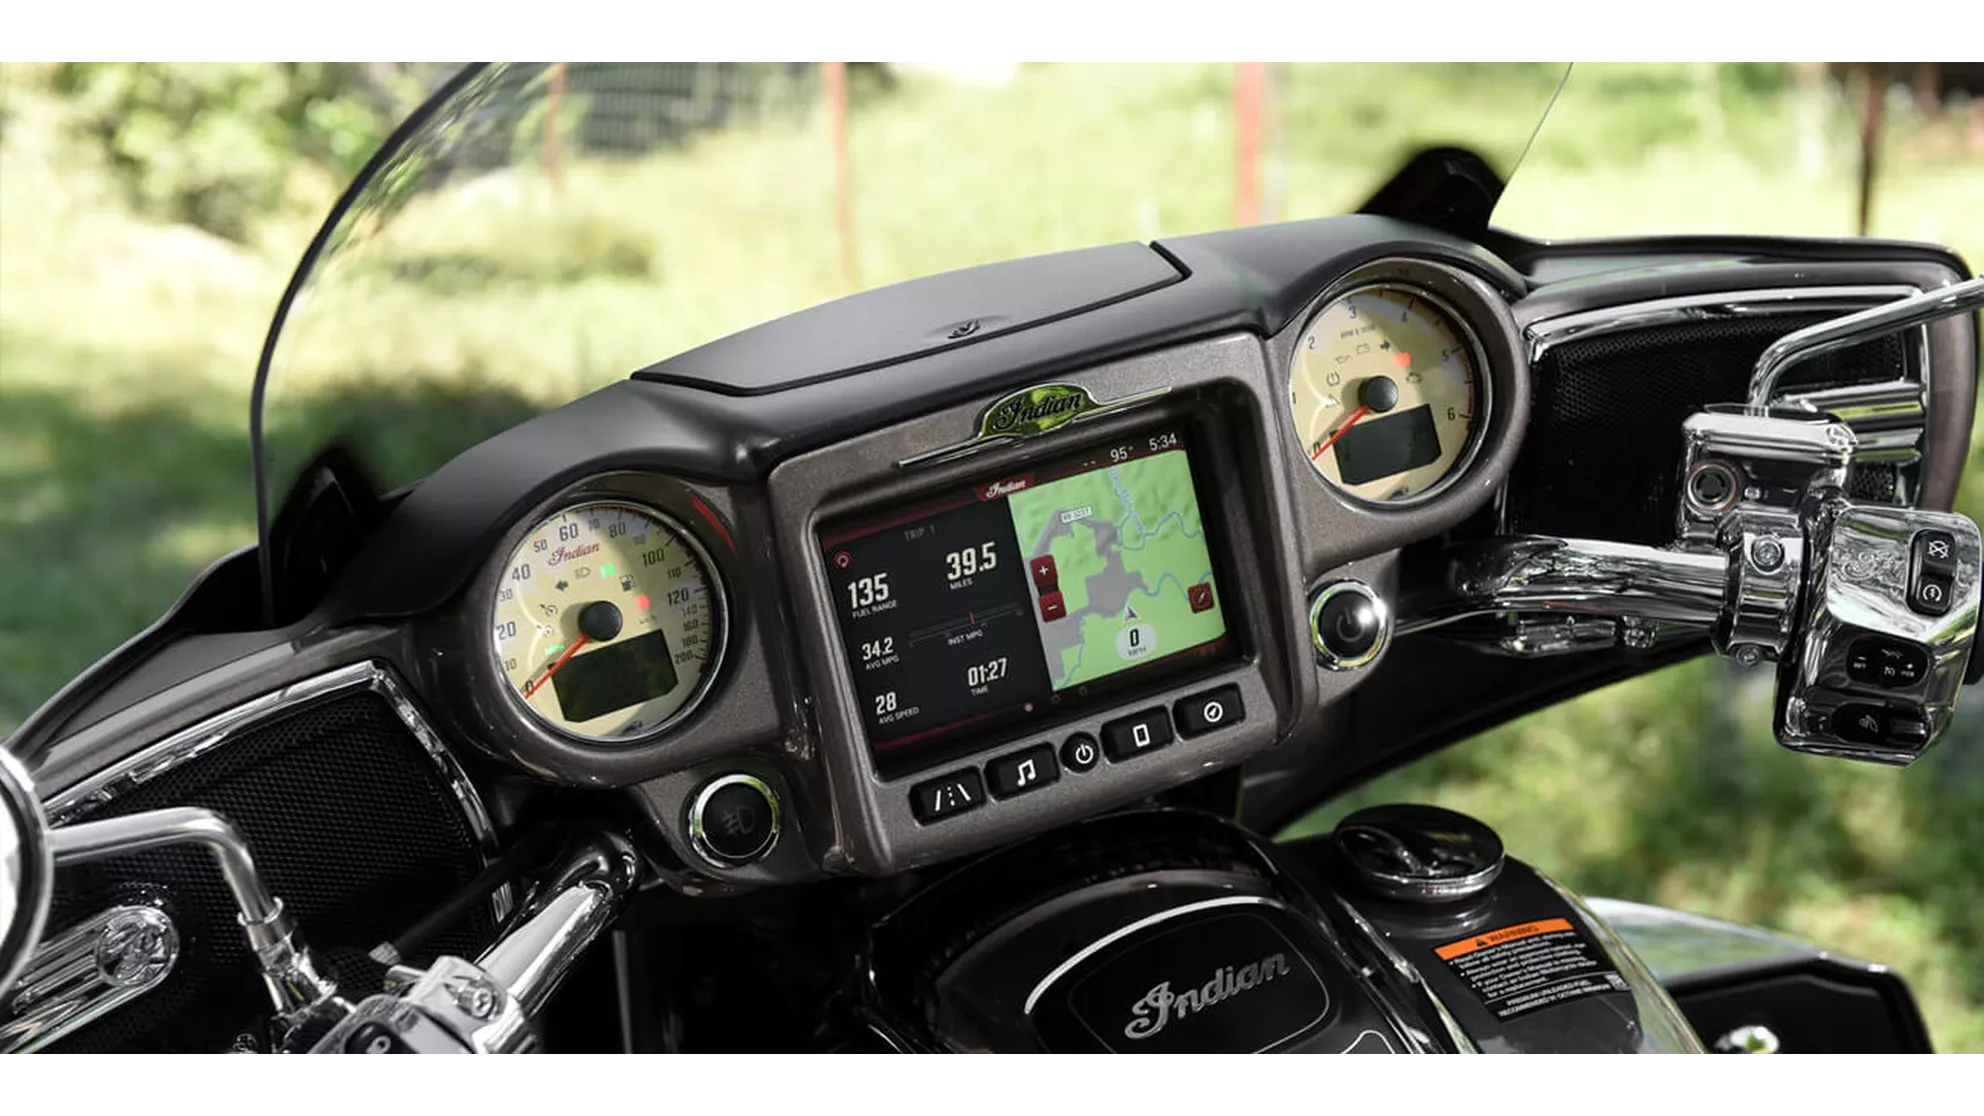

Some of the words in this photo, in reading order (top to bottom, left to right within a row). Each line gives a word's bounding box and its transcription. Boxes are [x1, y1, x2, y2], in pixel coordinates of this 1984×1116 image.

[1349, 305, 1357, 319] 3
[1308, 336, 1316, 349] 2
[994, 392, 1082, 430] Indian
[1447, 408, 1456, 422] 6
[1149, 433, 1177, 451] 5:34
[986, 479, 1026, 498] Indian
[560, 523, 579, 541] 60
[609, 522, 627, 539] 80
[904, 527, 926, 541] TRIP
[533, 539, 548, 553] 50
[547, 543, 601, 567] Indian
[642, 549, 665, 567] 100
[946, 542, 997, 580] 39.5
[512, 564, 531, 581] 40
[848, 572, 889, 610] 135
[950, 578, 973, 590] MILES
[500, 588, 513, 602] 30
[667, 587, 690, 607] 120
[852, 605, 872, 619] FUEL
[872, 600, 897, 613] RANGE
[496, 621, 516, 641] 20
[948, 634, 965, 646] INST
[966, 629, 984, 641] MPG
[1130, 628, 1139, 647] 0
[861, 637, 893, 660] 34.2
[504, 658, 517, 671] 10
[865, 659, 881, 671] AVG
[881, 655, 900, 666] MPG
[967, 657, 1007, 686] 01:27
[971, 685, 989, 696] TIME
[875, 691, 897, 715] 28
[878, 713, 894, 724] AVG
[895, 706, 920, 720] SPEED
[1124, 953, 1290, 1039] Indian
